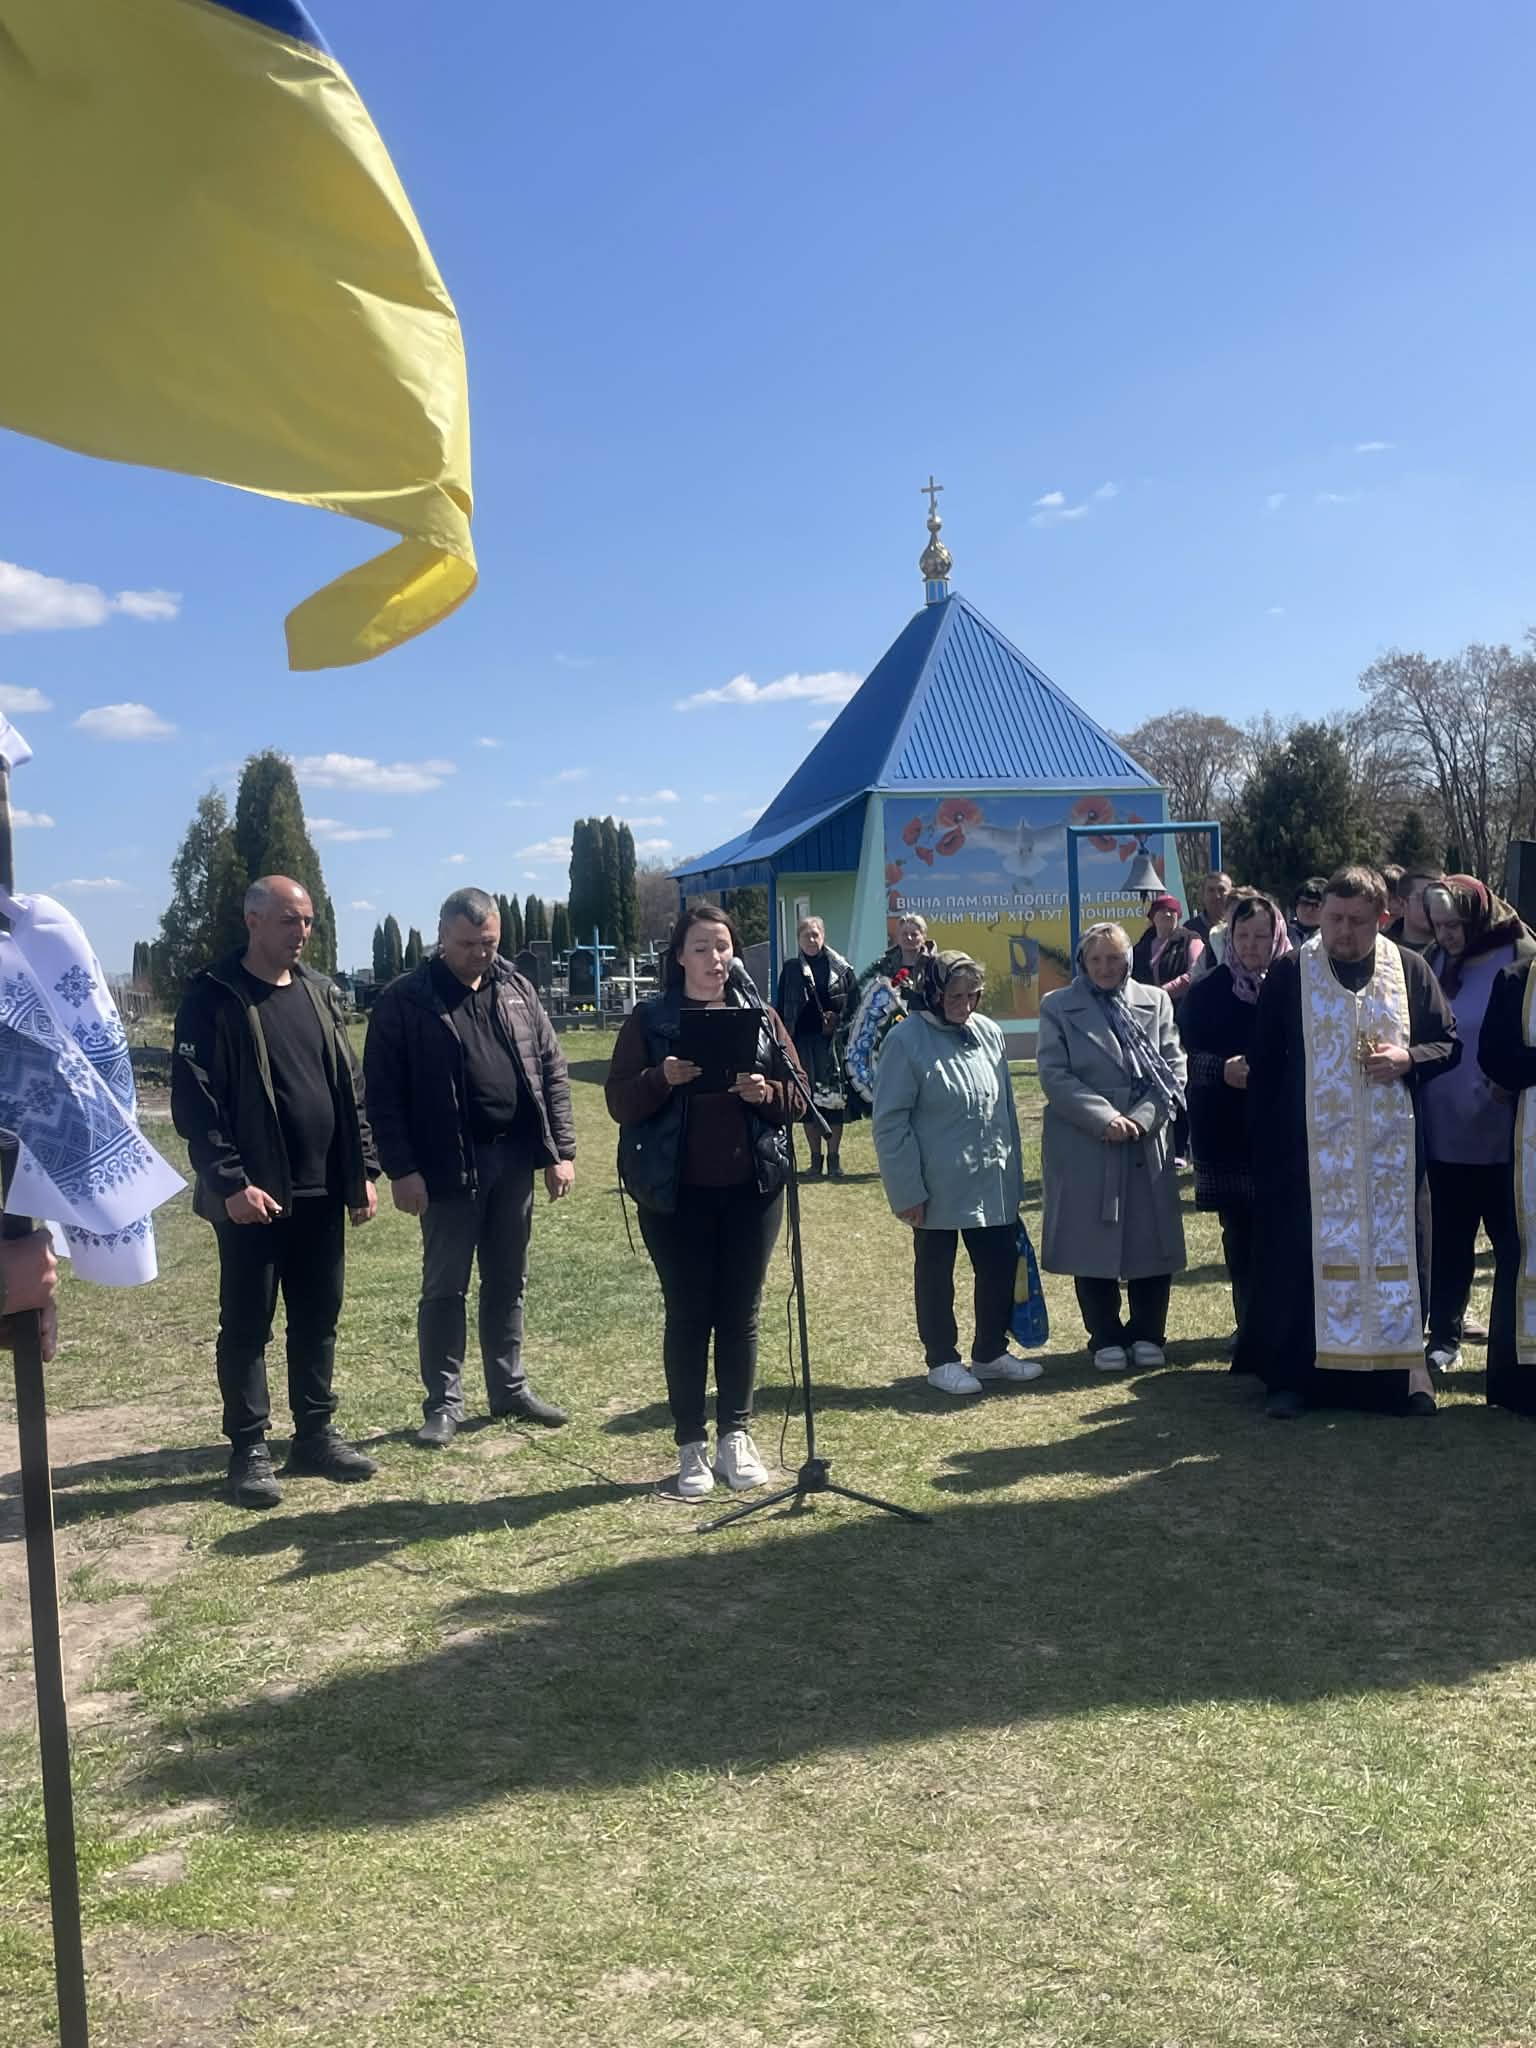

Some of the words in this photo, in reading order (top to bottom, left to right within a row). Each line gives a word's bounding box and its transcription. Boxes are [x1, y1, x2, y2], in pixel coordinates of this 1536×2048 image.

[896, 896, 940, 909] ВІЧНА
[1014, 893, 1090, 905] ПОЛЕГЛМ
[930, 911, 964, 924] УСІМ
[1007, 910, 1035, 922] ХТО
[1040, 909, 1063, 921] ТУТ
[1068, 907, 1147, 920] ПОЧИВАЄ!
